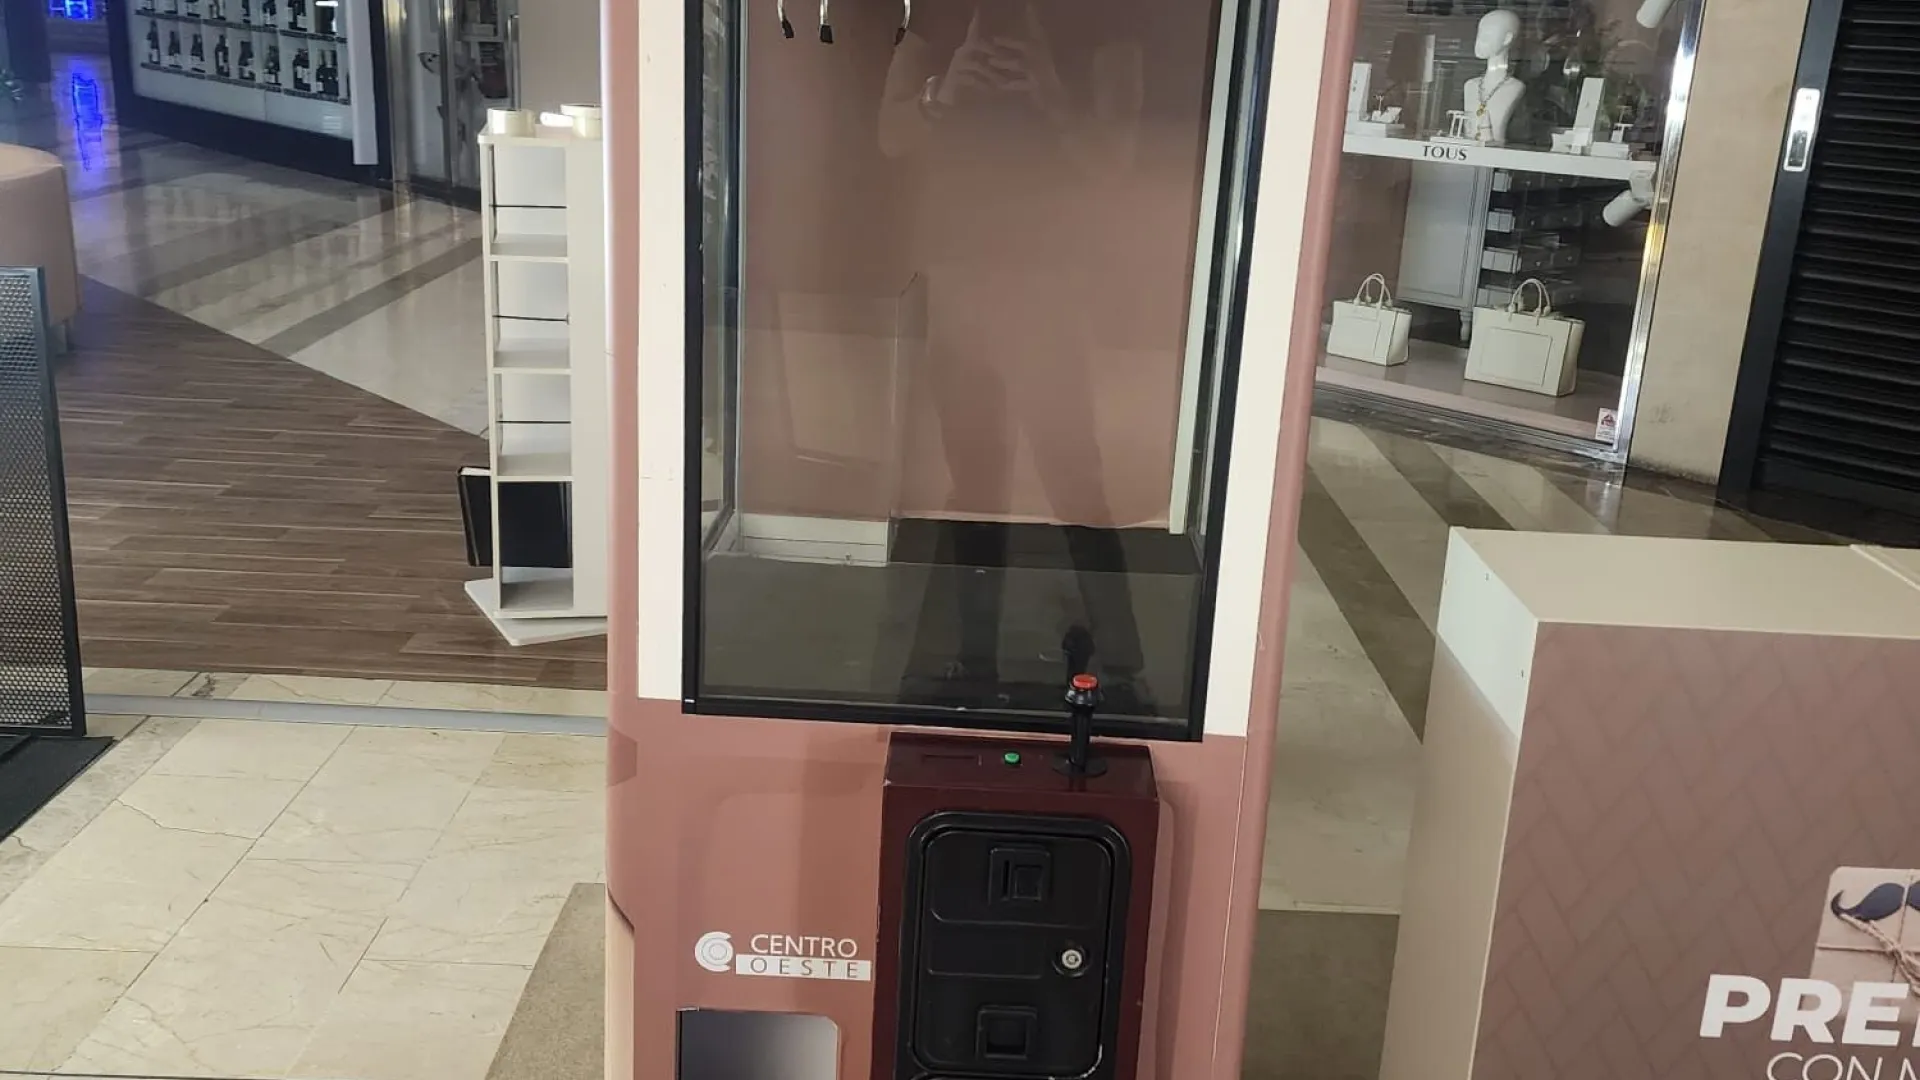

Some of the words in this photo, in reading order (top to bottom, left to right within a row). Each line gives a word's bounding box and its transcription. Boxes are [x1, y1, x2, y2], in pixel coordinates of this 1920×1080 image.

[1423, 145, 1468, 161] TOUS
[750, 933, 858, 958] CENTRO
[750, 957, 859, 979] OESTE
[1700, 973, 1920, 1048] PRE
[1766, 1052, 1883, 1080] CON
